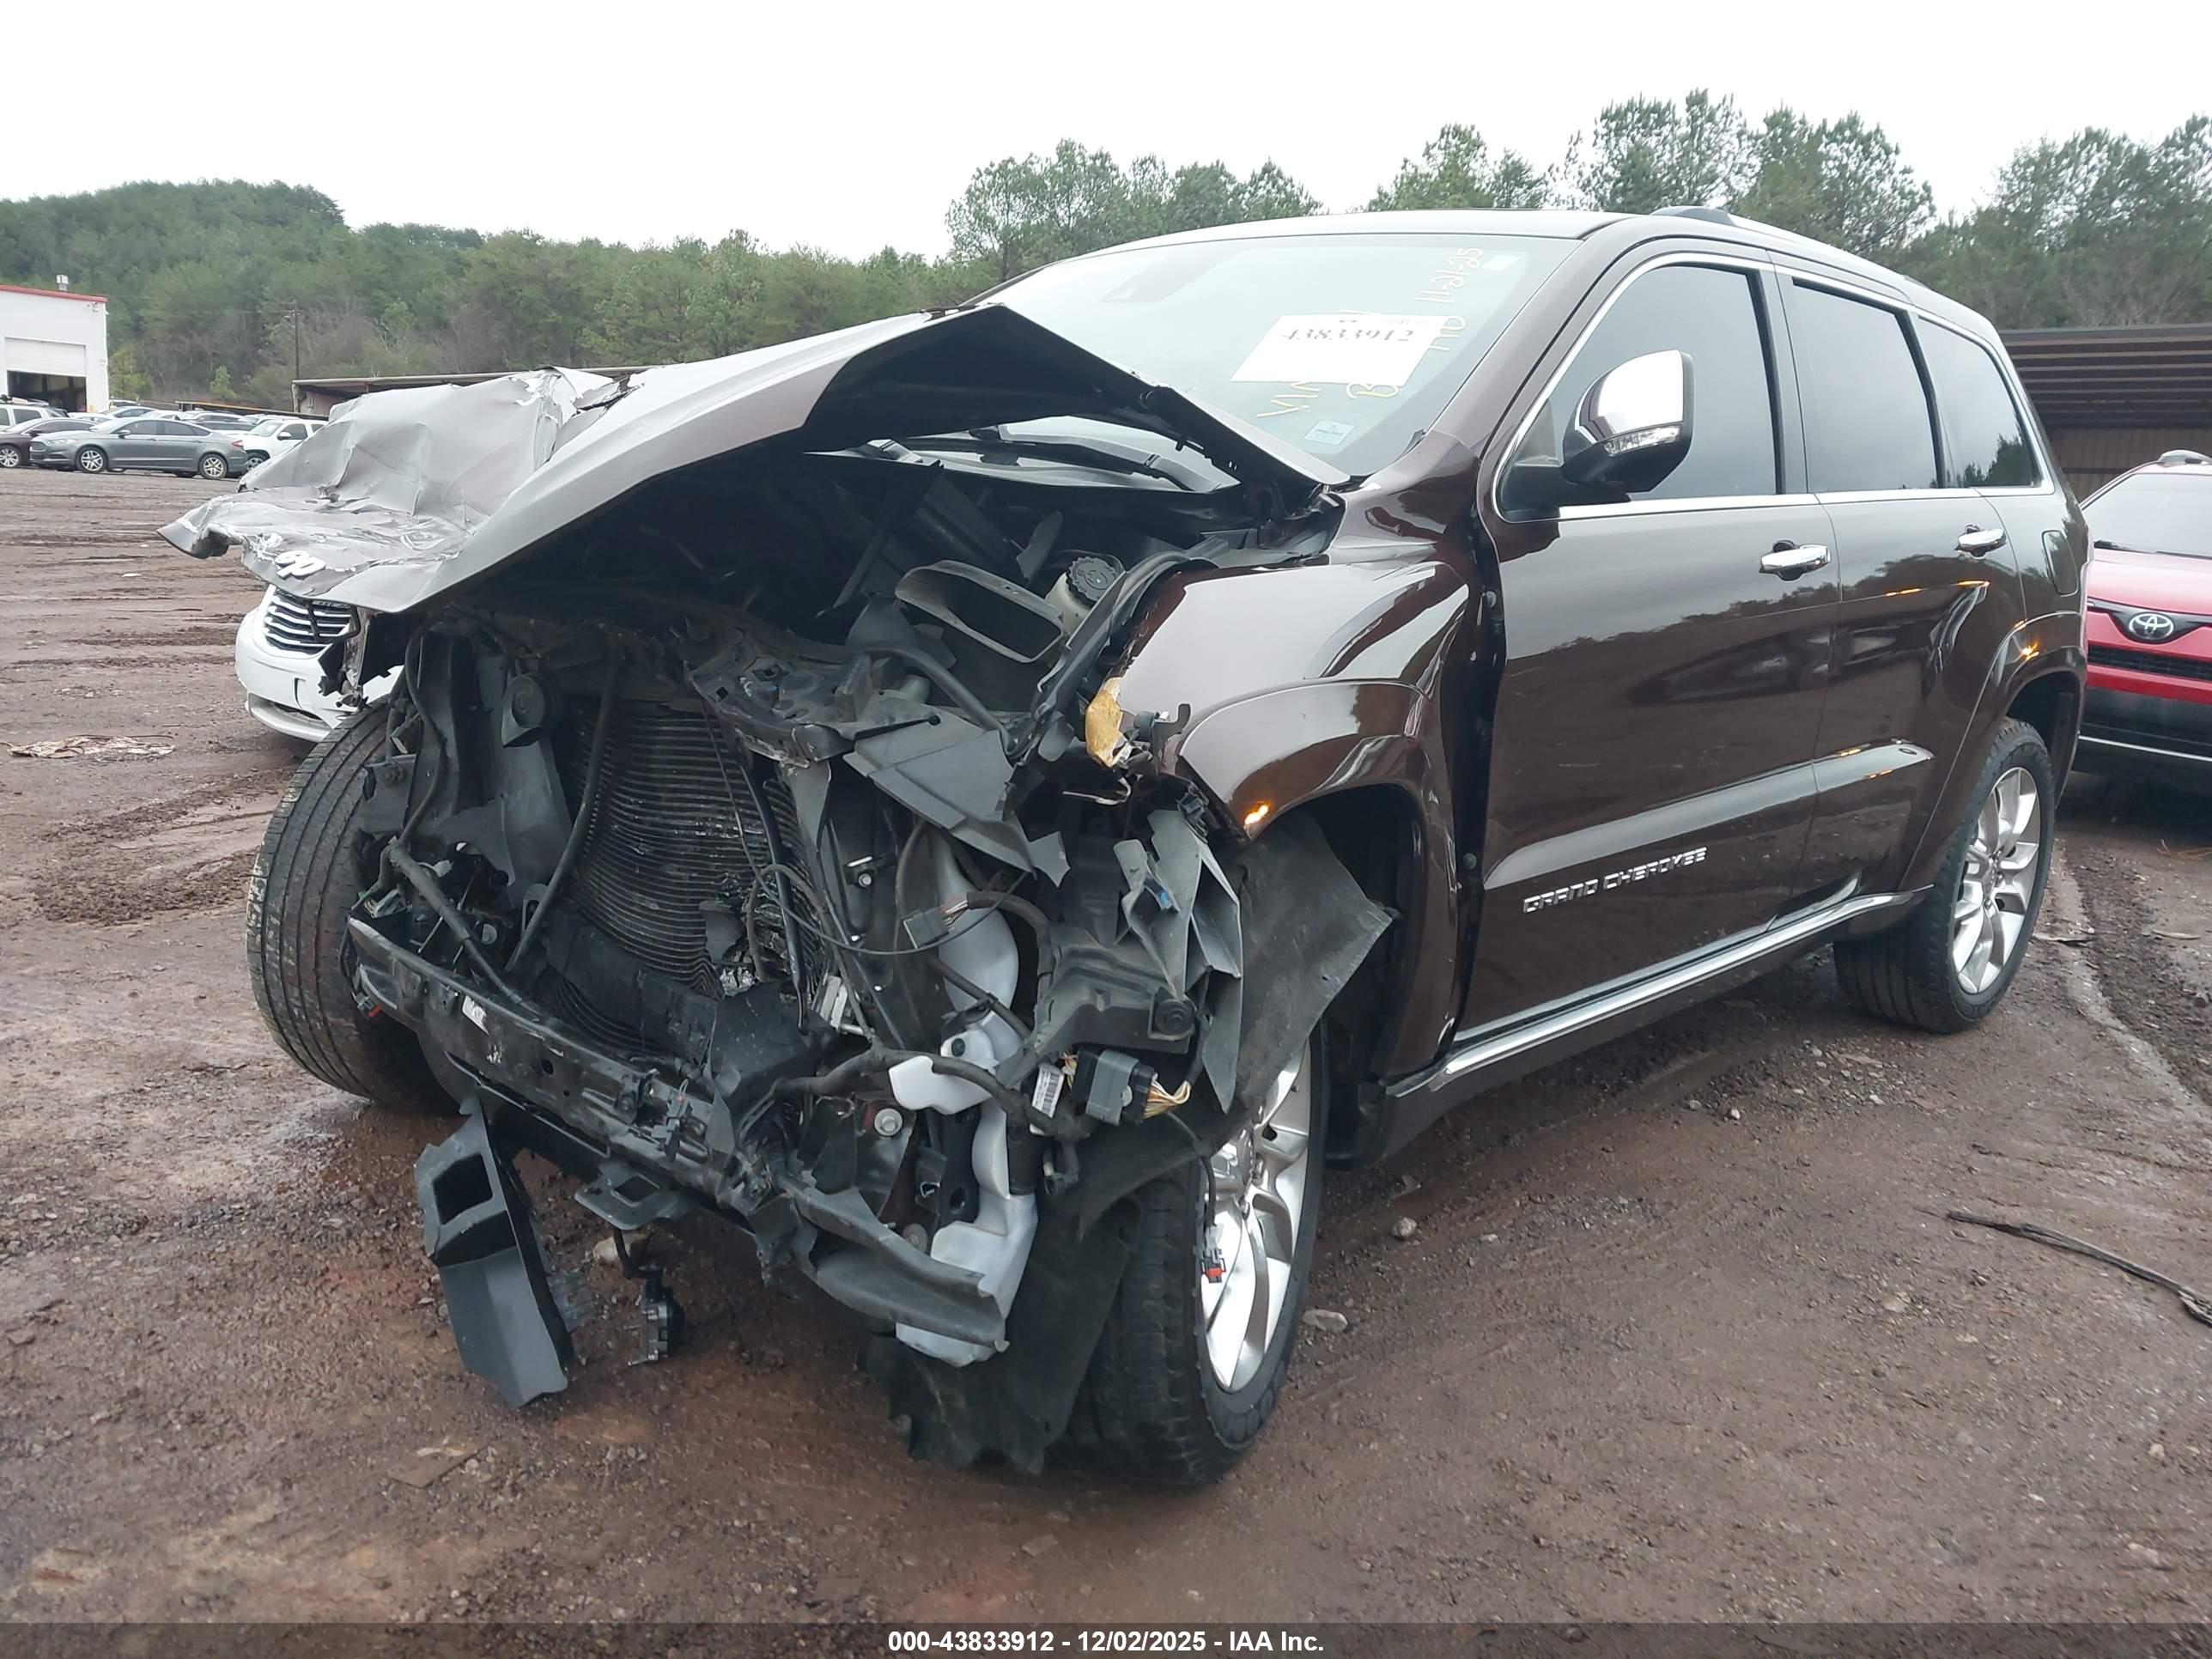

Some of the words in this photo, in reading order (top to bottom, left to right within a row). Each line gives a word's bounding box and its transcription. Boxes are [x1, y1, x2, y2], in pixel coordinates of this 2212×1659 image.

[1415, 247, 1484, 302] 11-21-25
[1522, 878, 1599, 913] GRAND
[1602, 847, 1708, 890] CHEROKEE
